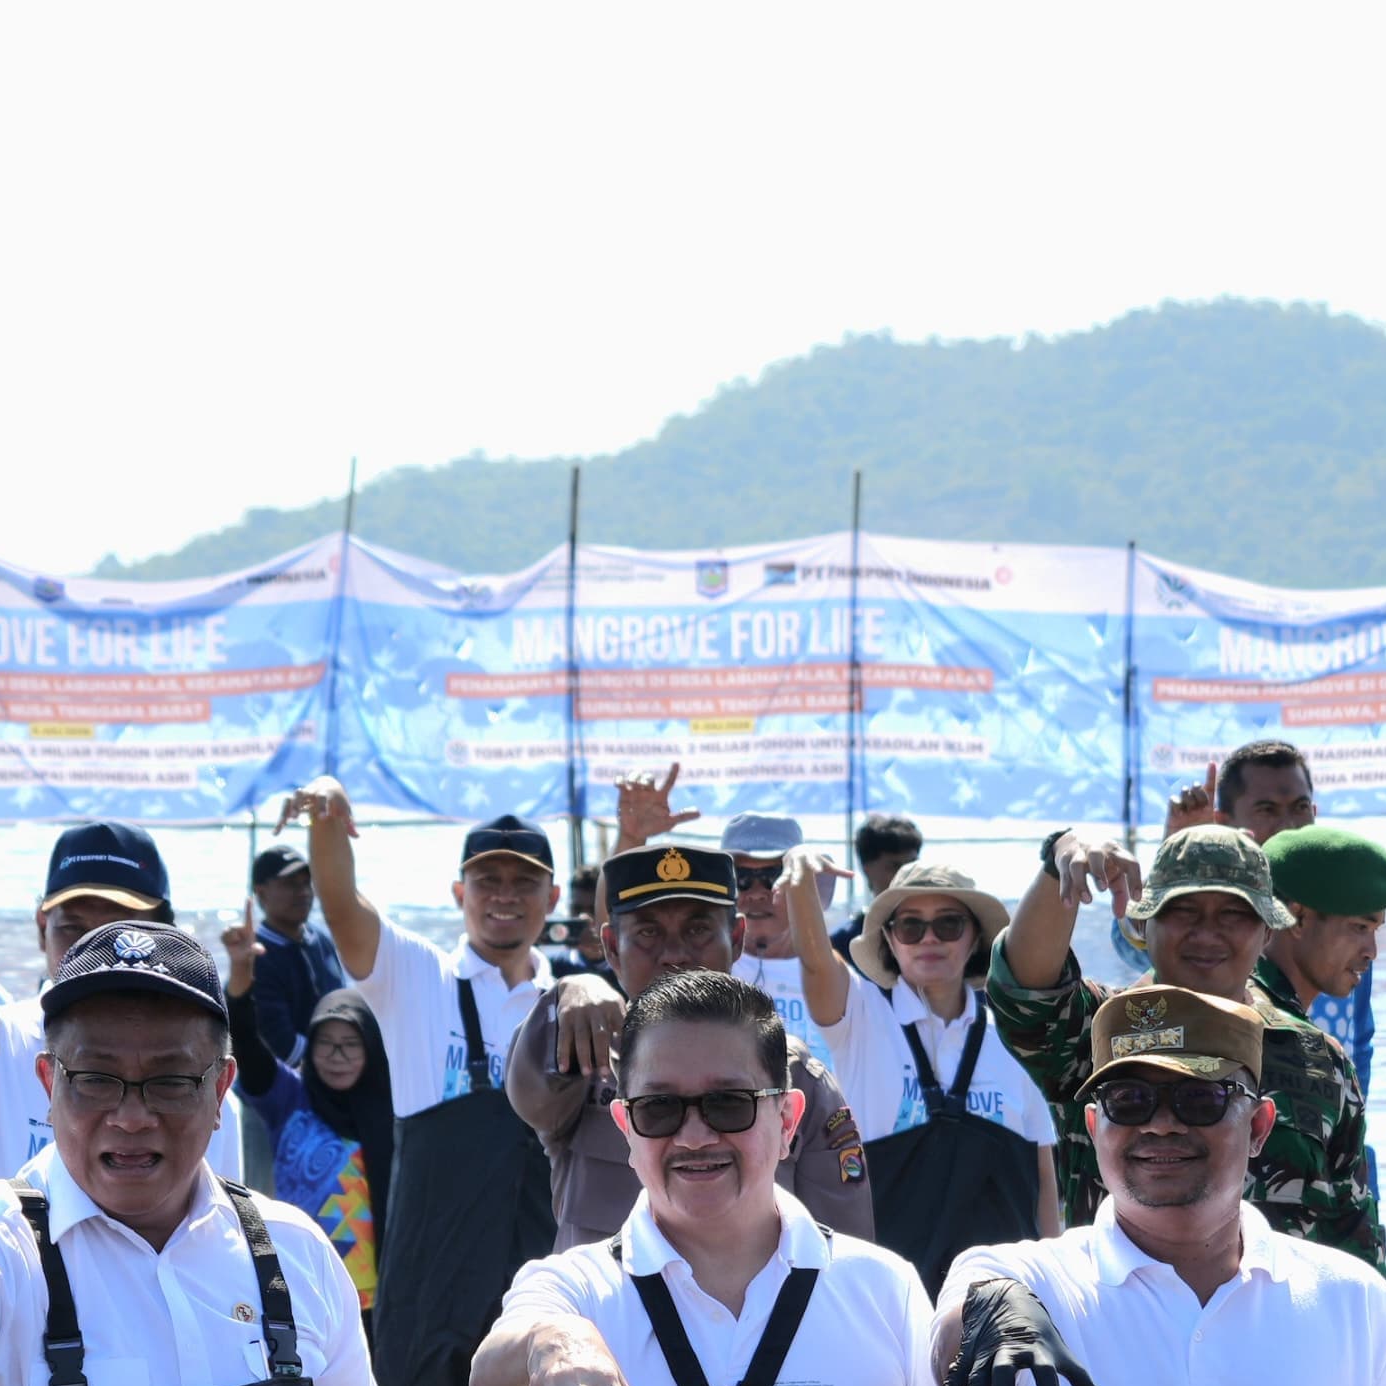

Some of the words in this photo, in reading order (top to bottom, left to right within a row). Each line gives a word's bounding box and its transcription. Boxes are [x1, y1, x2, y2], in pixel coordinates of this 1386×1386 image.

[68, 617, 142, 667] FOR
[152, 613, 229, 664] LIFE
[512, 614, 720, 663] MANGROVE
[730, 610, 801, 659] FOR
[809, 608, 886, 655] LIFE
[1314, 773, 1348, 786] UNA
